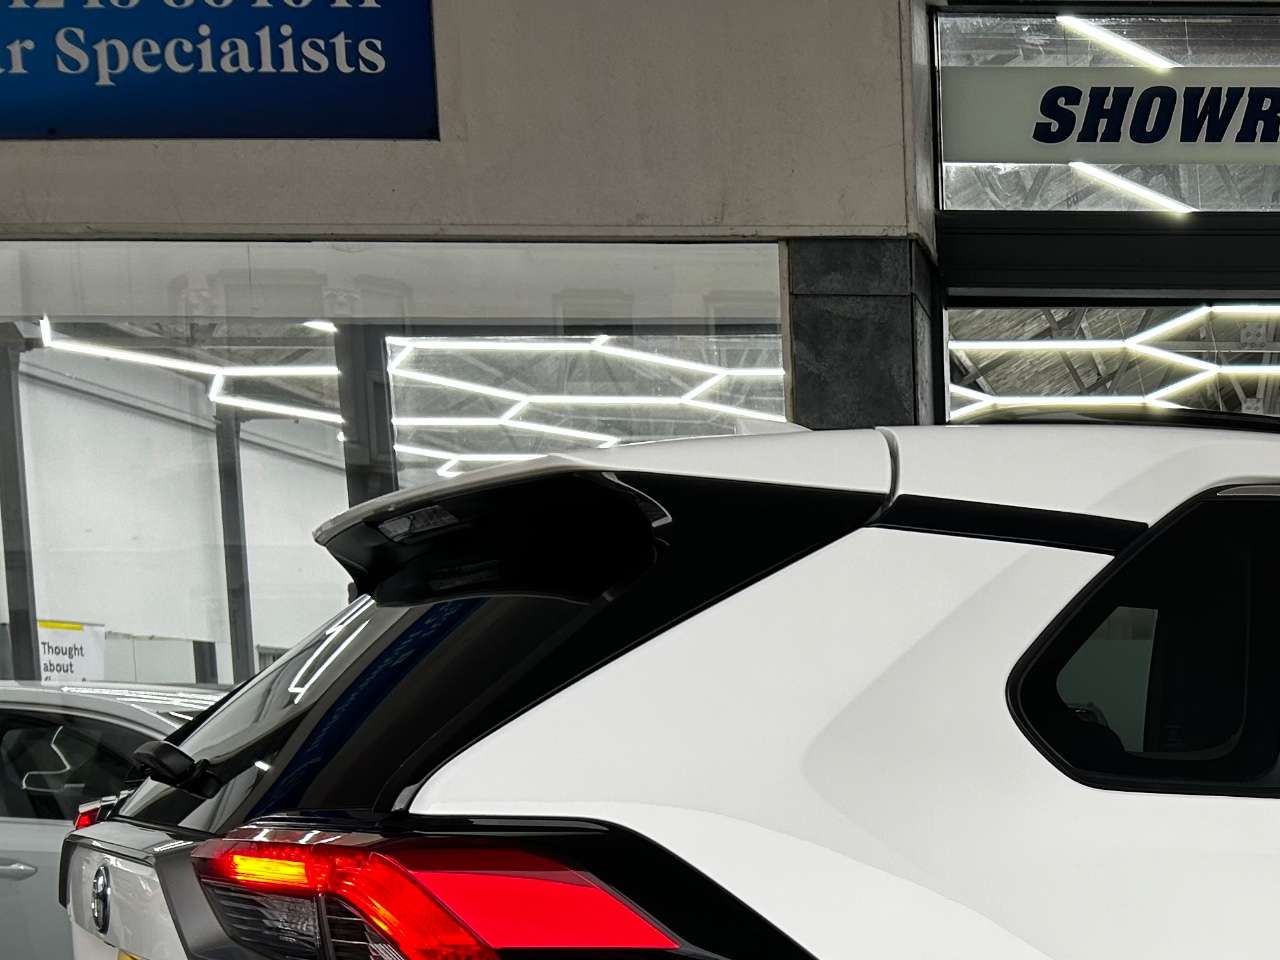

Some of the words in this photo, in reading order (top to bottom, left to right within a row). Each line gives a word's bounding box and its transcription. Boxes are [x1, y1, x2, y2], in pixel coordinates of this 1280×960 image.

[0, 38, 36, 75] r
[54, 23, 387, 87] Specialists
[41, 641, 85, 659] Thought
[43, 660, 75, 674] about
